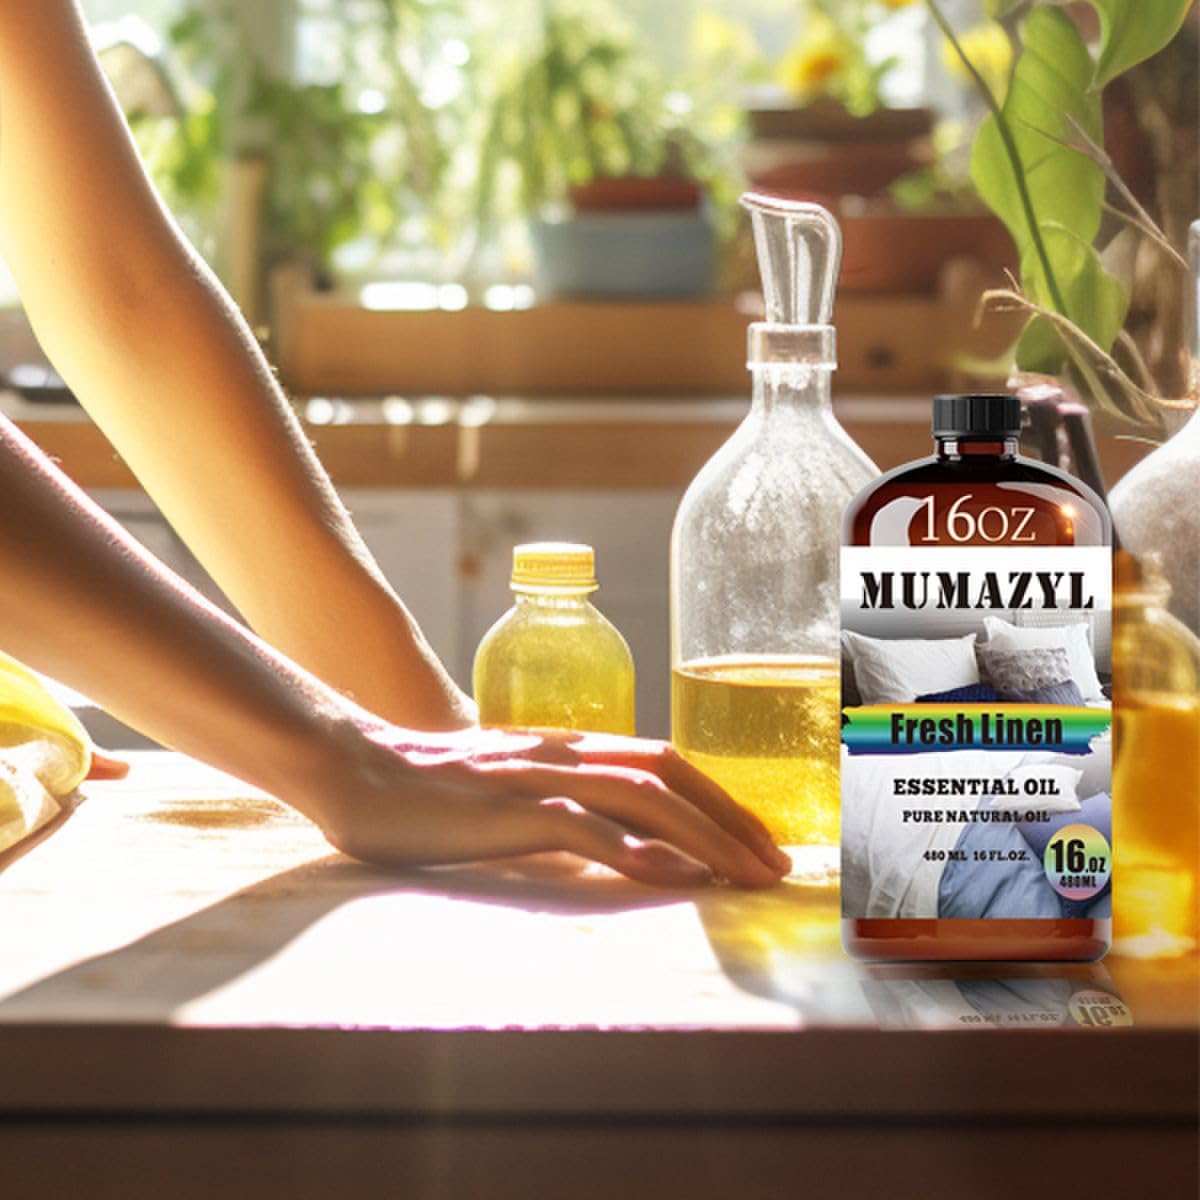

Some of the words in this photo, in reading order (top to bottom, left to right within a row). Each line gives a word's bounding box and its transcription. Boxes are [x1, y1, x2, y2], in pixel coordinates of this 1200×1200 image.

[860, 572, 1094, 609] MUMAZYL
[890, 714, 973, 745] Fresh
[981, 714, 1062, 745] Linen
[893, 778, 1019, 796] ESSENTIAL
[1024, 778, 1060, 796] OIL
[903, 810, 943, 823] PURE
[946, 810, 1022, 823] NATURAL
[1025, 810, 1050, 823] OIL
[923, 850, 945, 861] 480
[948, 850, 968, 861] ML
[973, 850, 987, 861] 16
[1059, 875, 1097, 888] 480ML
